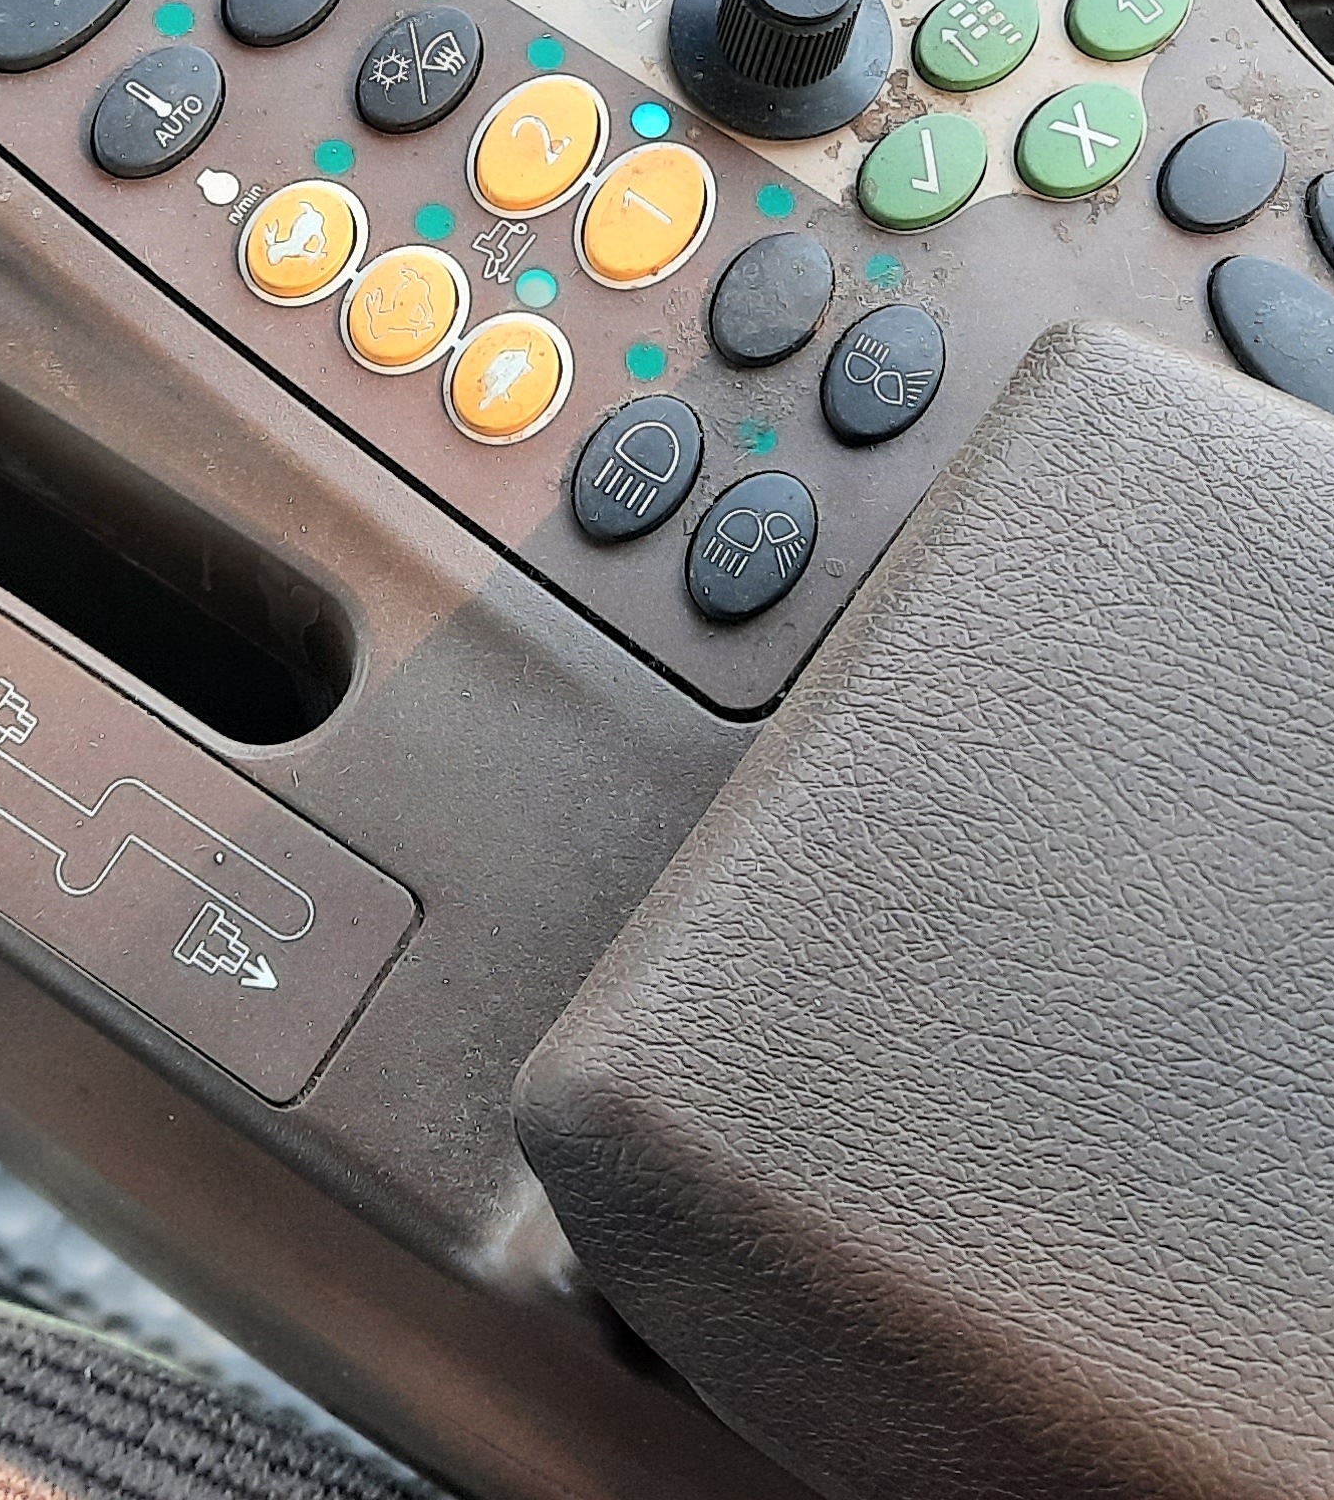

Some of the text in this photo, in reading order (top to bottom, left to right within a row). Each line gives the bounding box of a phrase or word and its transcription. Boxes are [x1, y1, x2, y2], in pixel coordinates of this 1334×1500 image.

[154, 95, 203, 148] AUTO
[510, 114, 573, 166] 2
[227, 184, 264, 226] n/min
[622, 187, 673, 225] 1
